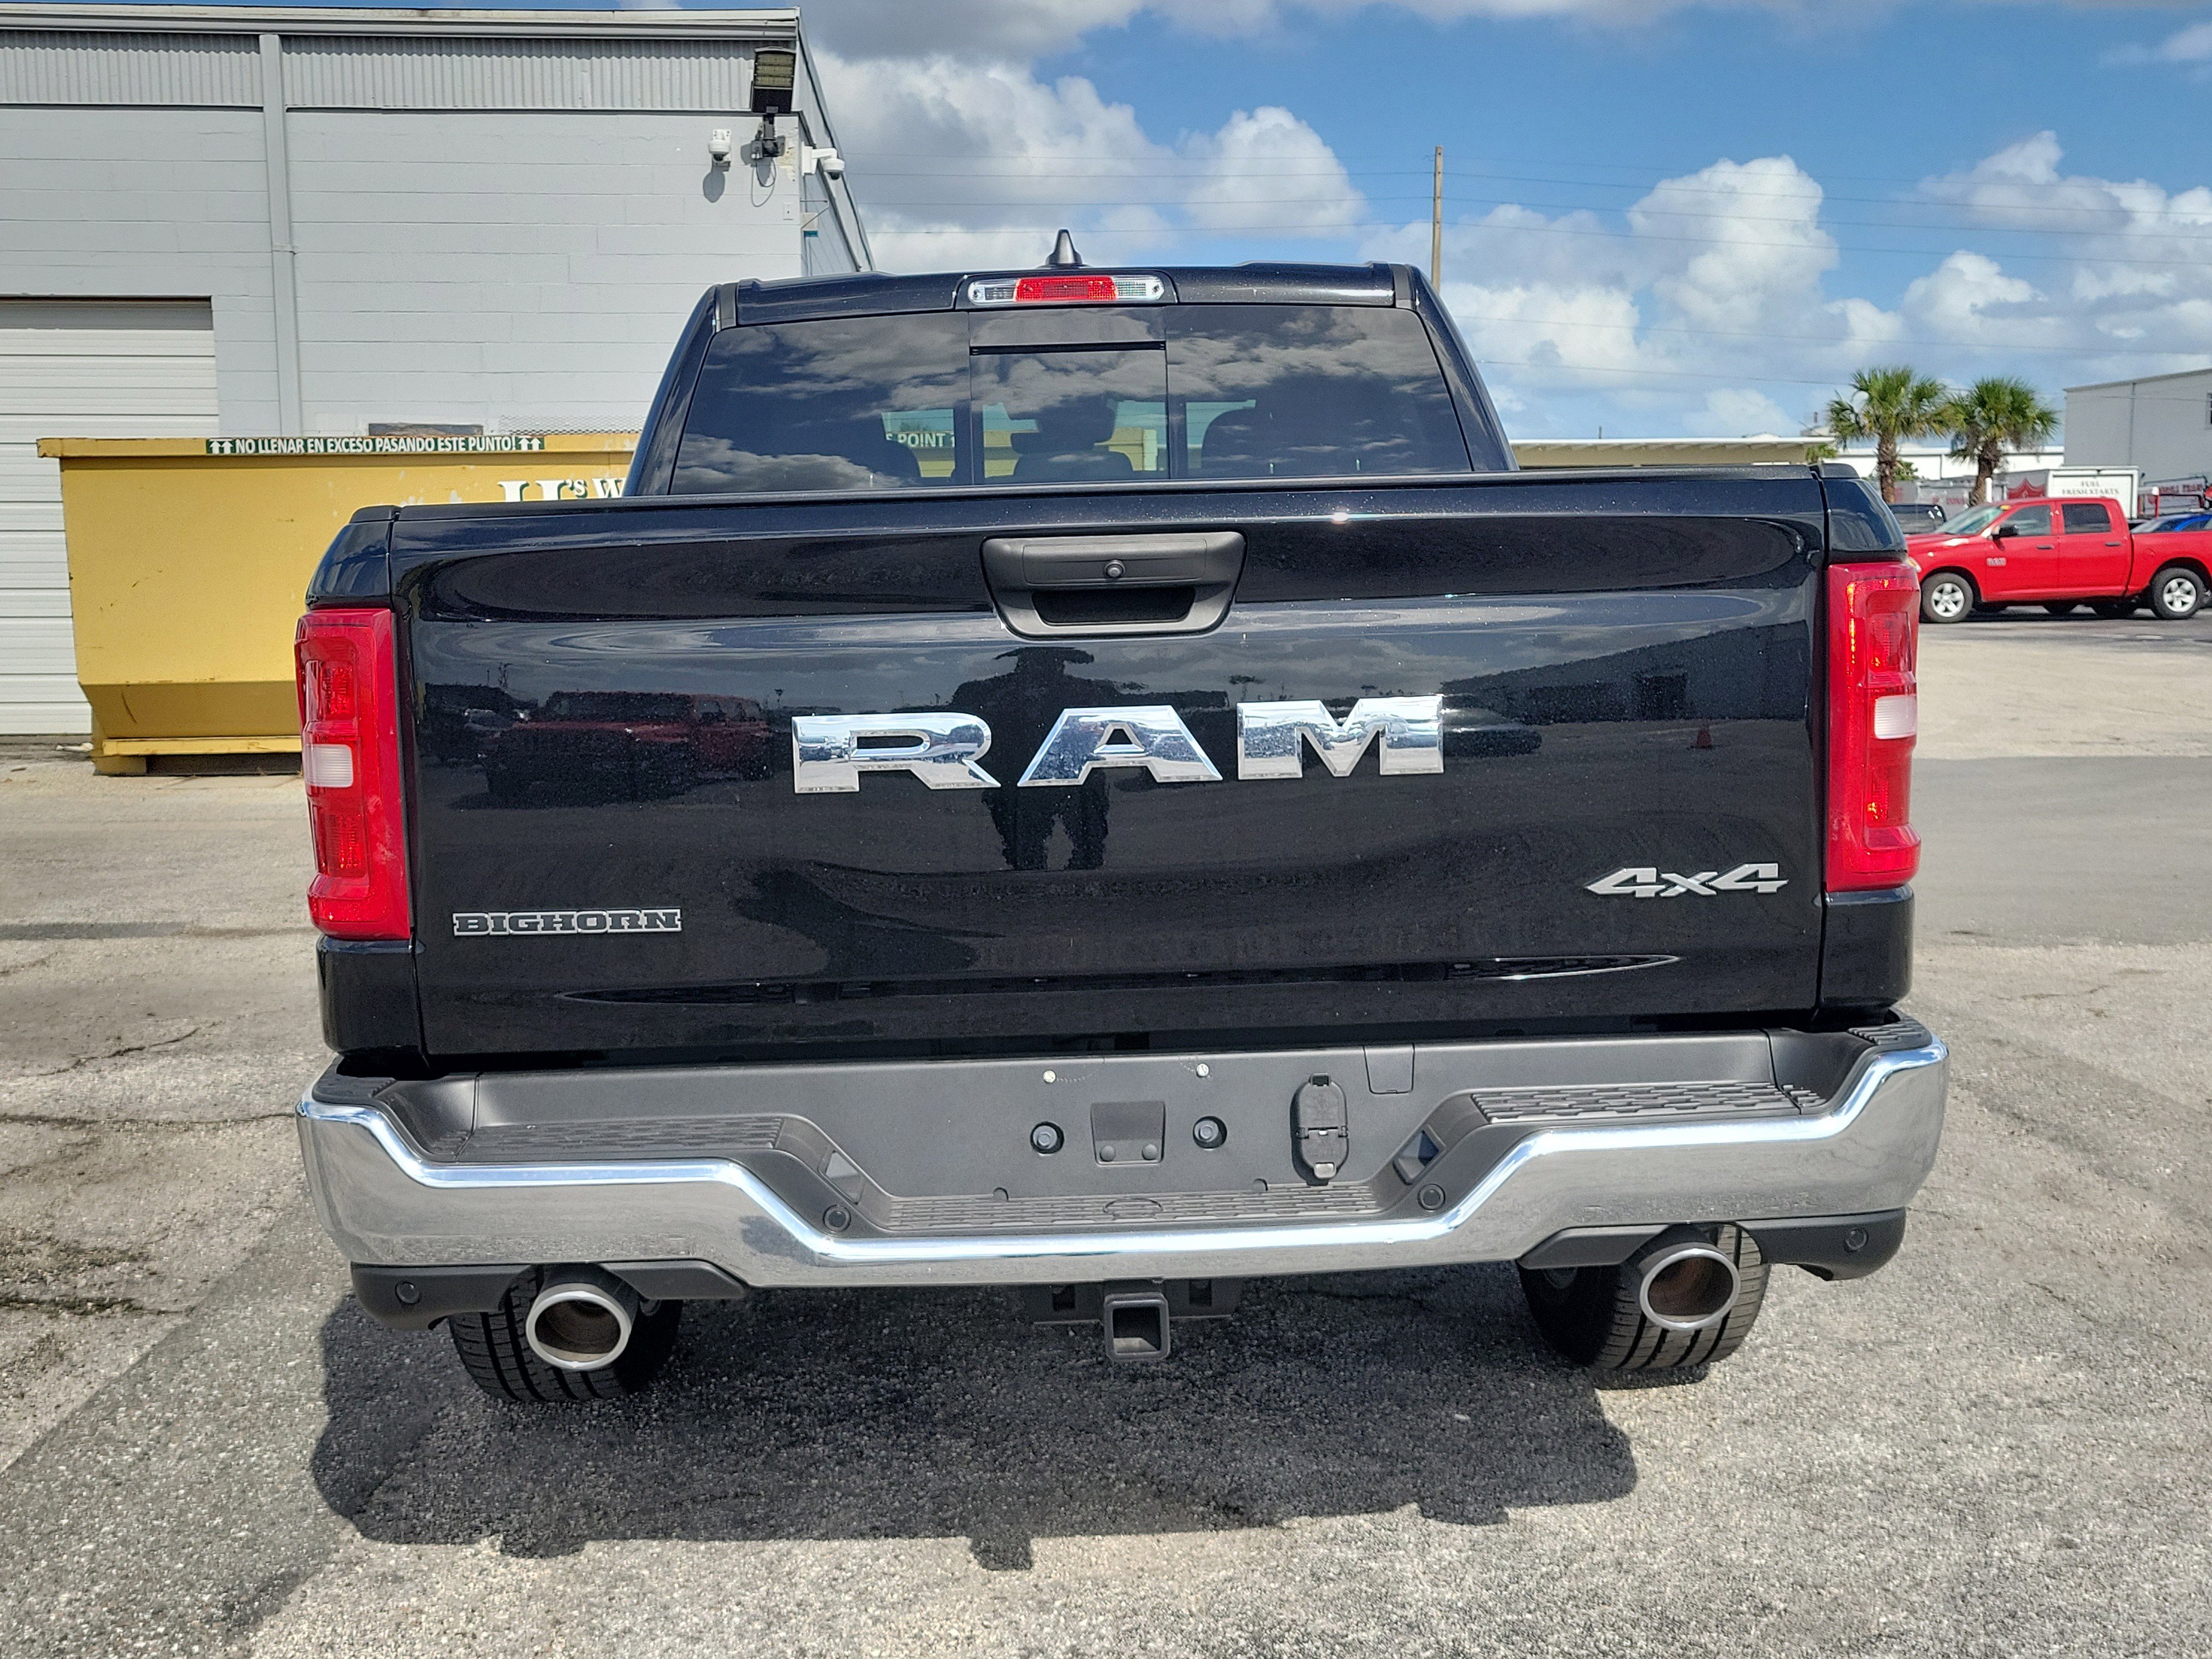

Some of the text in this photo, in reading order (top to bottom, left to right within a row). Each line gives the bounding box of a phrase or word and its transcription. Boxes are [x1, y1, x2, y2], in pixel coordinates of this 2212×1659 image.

[235, 436, 516, 454] NO LLENAR EN EXCESO PASANDO ESTE PUNTO!
[897, 432, 946, 447] POINT
[792, 695, 1444, 794] RAM
[453, 909, 682, 936] BIGHORN
